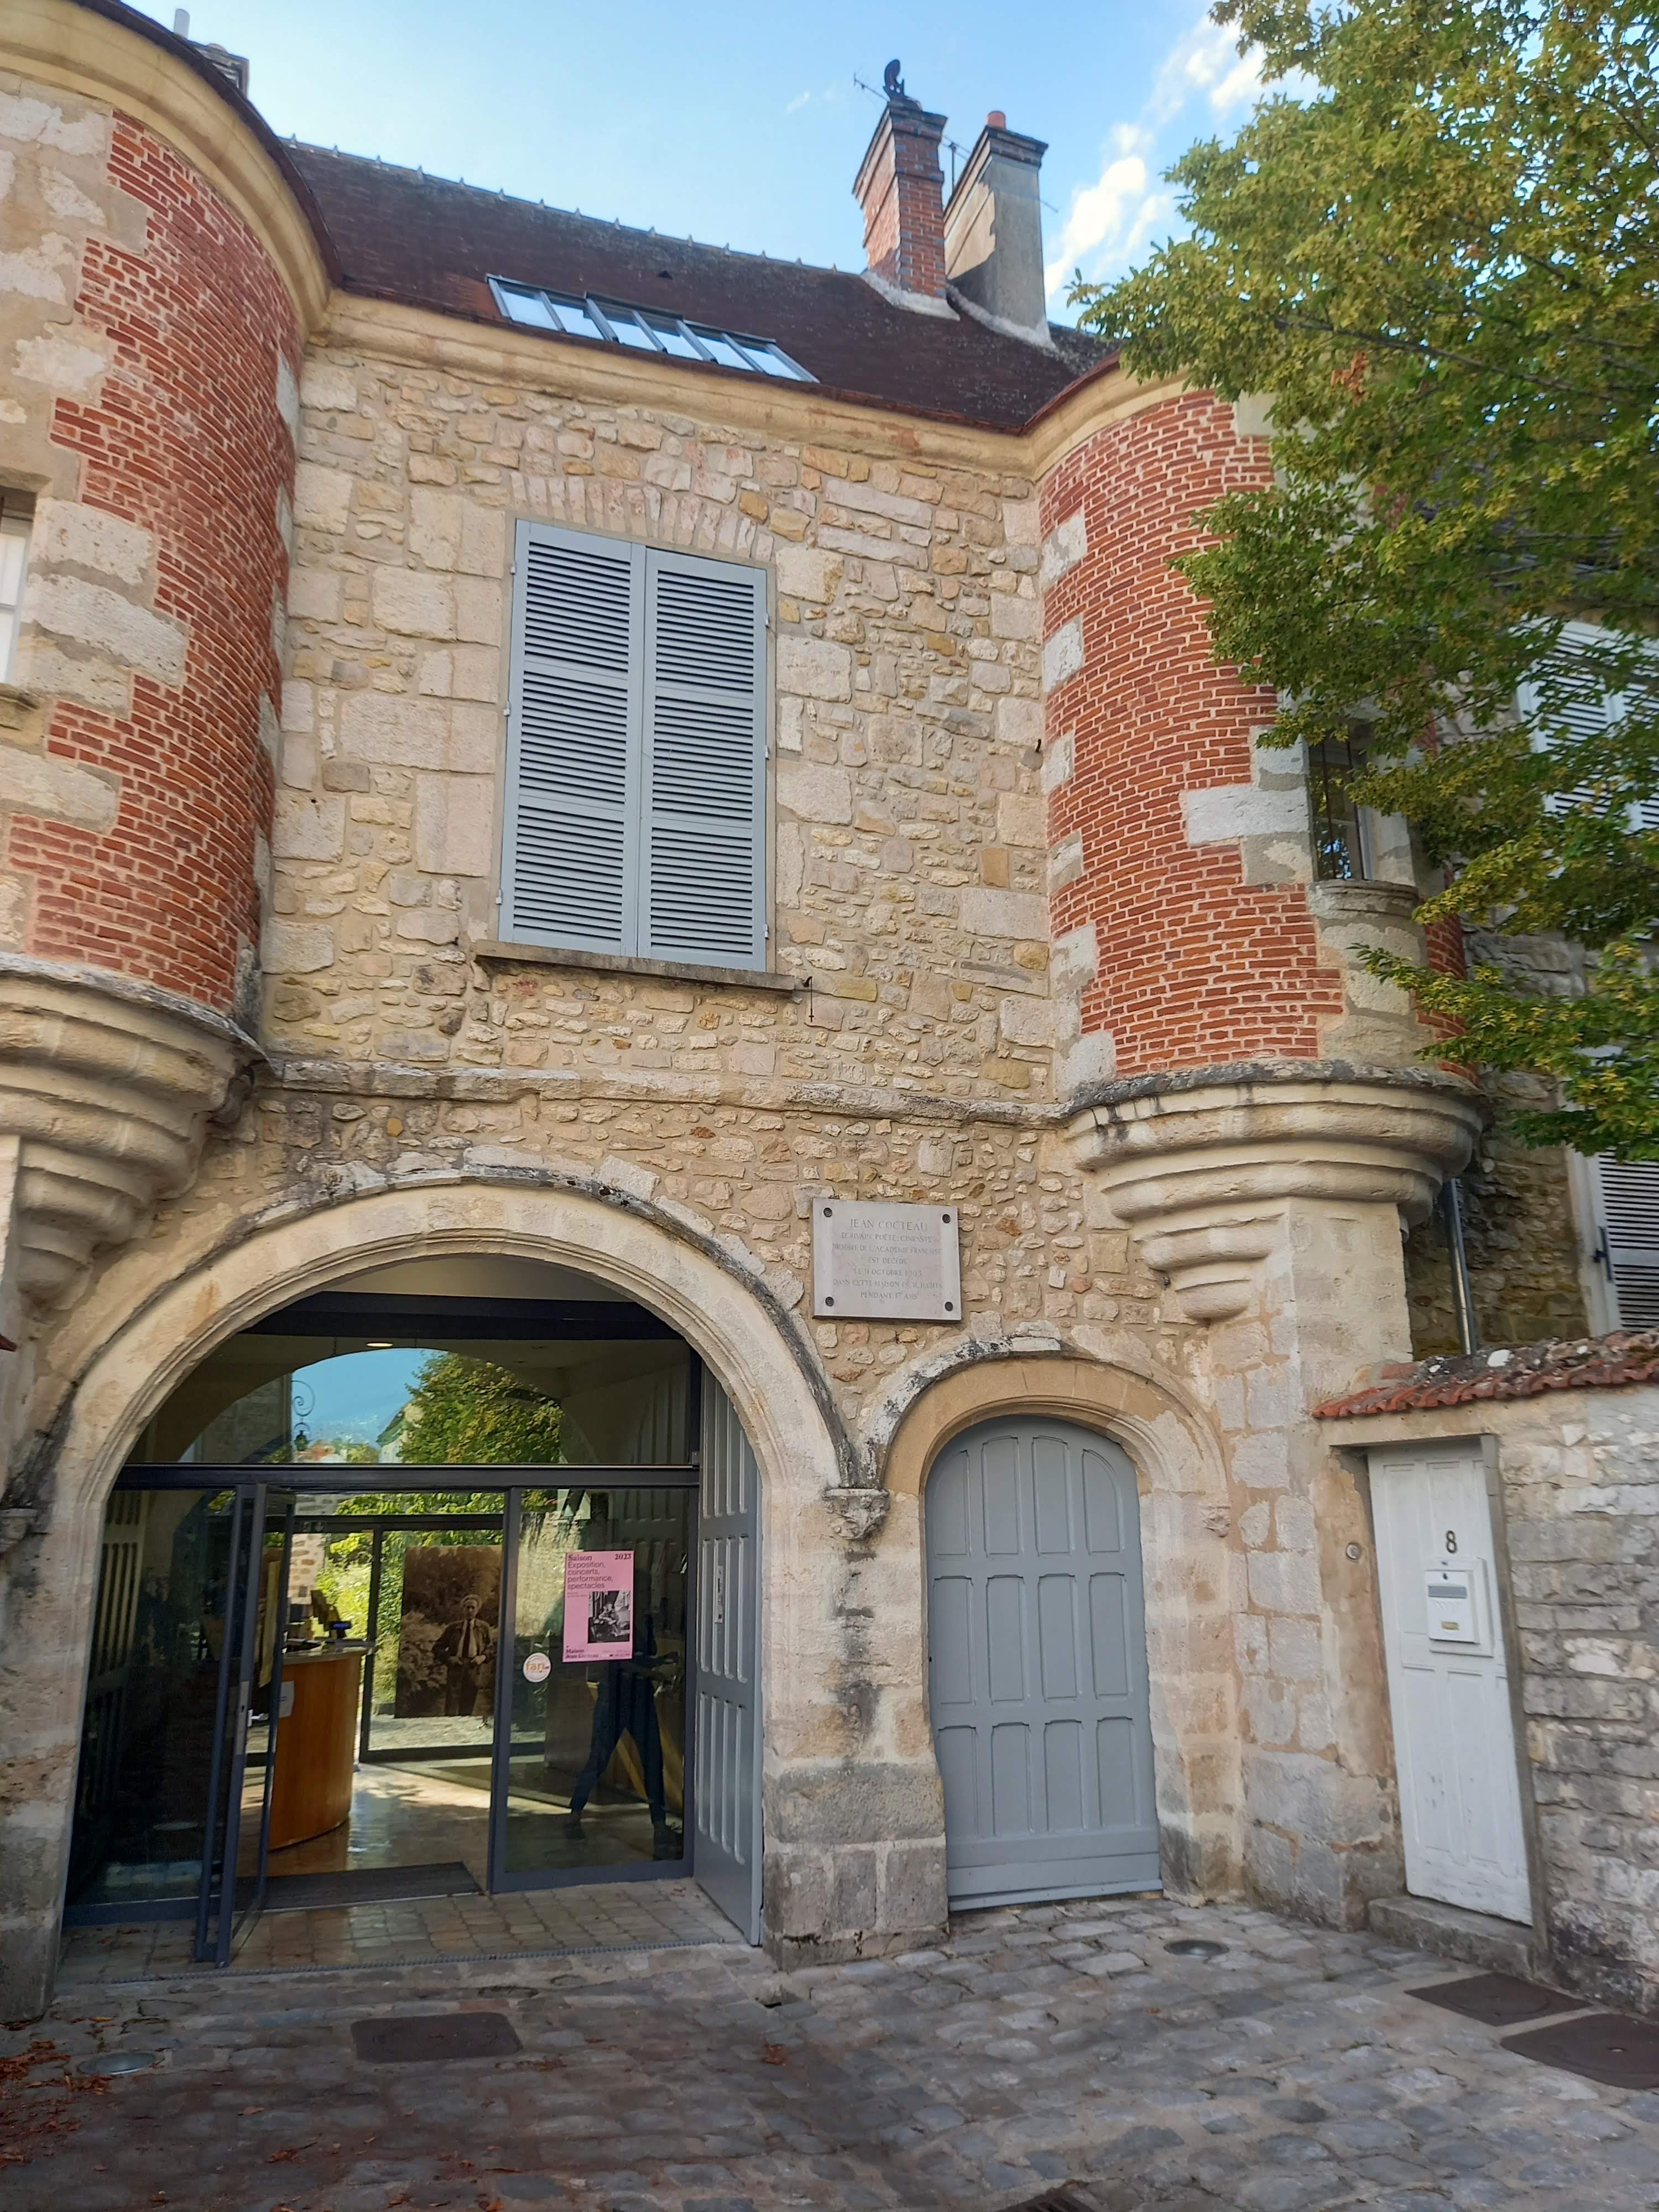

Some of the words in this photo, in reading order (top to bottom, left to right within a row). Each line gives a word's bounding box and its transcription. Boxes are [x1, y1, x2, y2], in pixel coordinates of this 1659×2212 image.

[849, 1219, 874, 1230] JEAN
[878, 1220, 927, 1231] COCTEAU
[875, 1280, 900, 1288] MAISON
[1445, 1530, 1458, 1554] 8
[568, 1561, 606, 1569] Exposition,
[567, 1575, 614, 1584] performance,
[567, 1582, 605, 1590] spectacles
